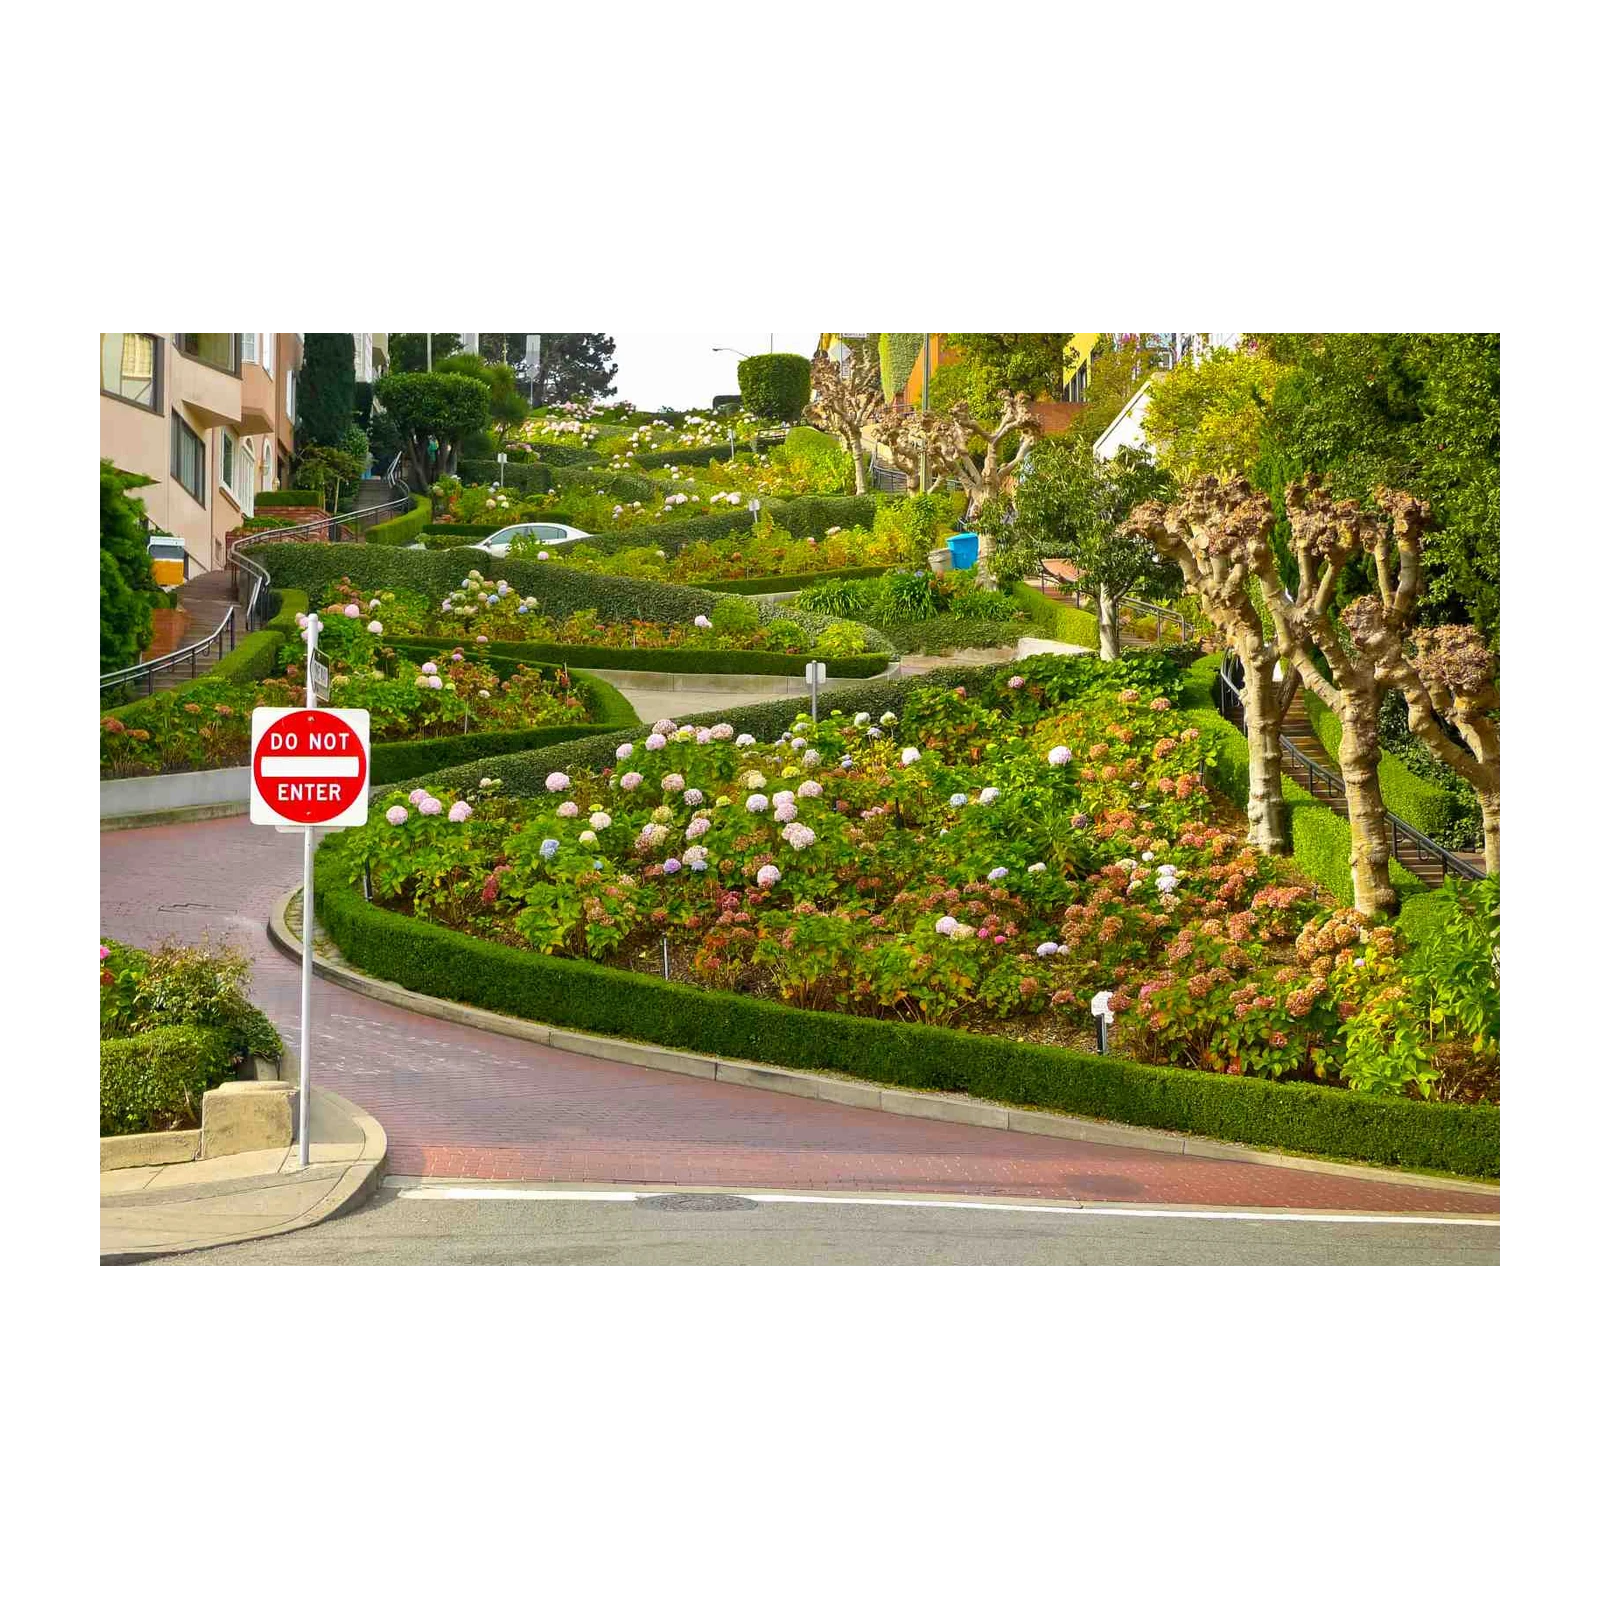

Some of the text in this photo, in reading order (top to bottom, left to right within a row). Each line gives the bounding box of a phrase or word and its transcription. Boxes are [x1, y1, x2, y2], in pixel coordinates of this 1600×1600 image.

[270, 732, 350, 750] DO NOT
[278, 783, 341, 801] ENTER
